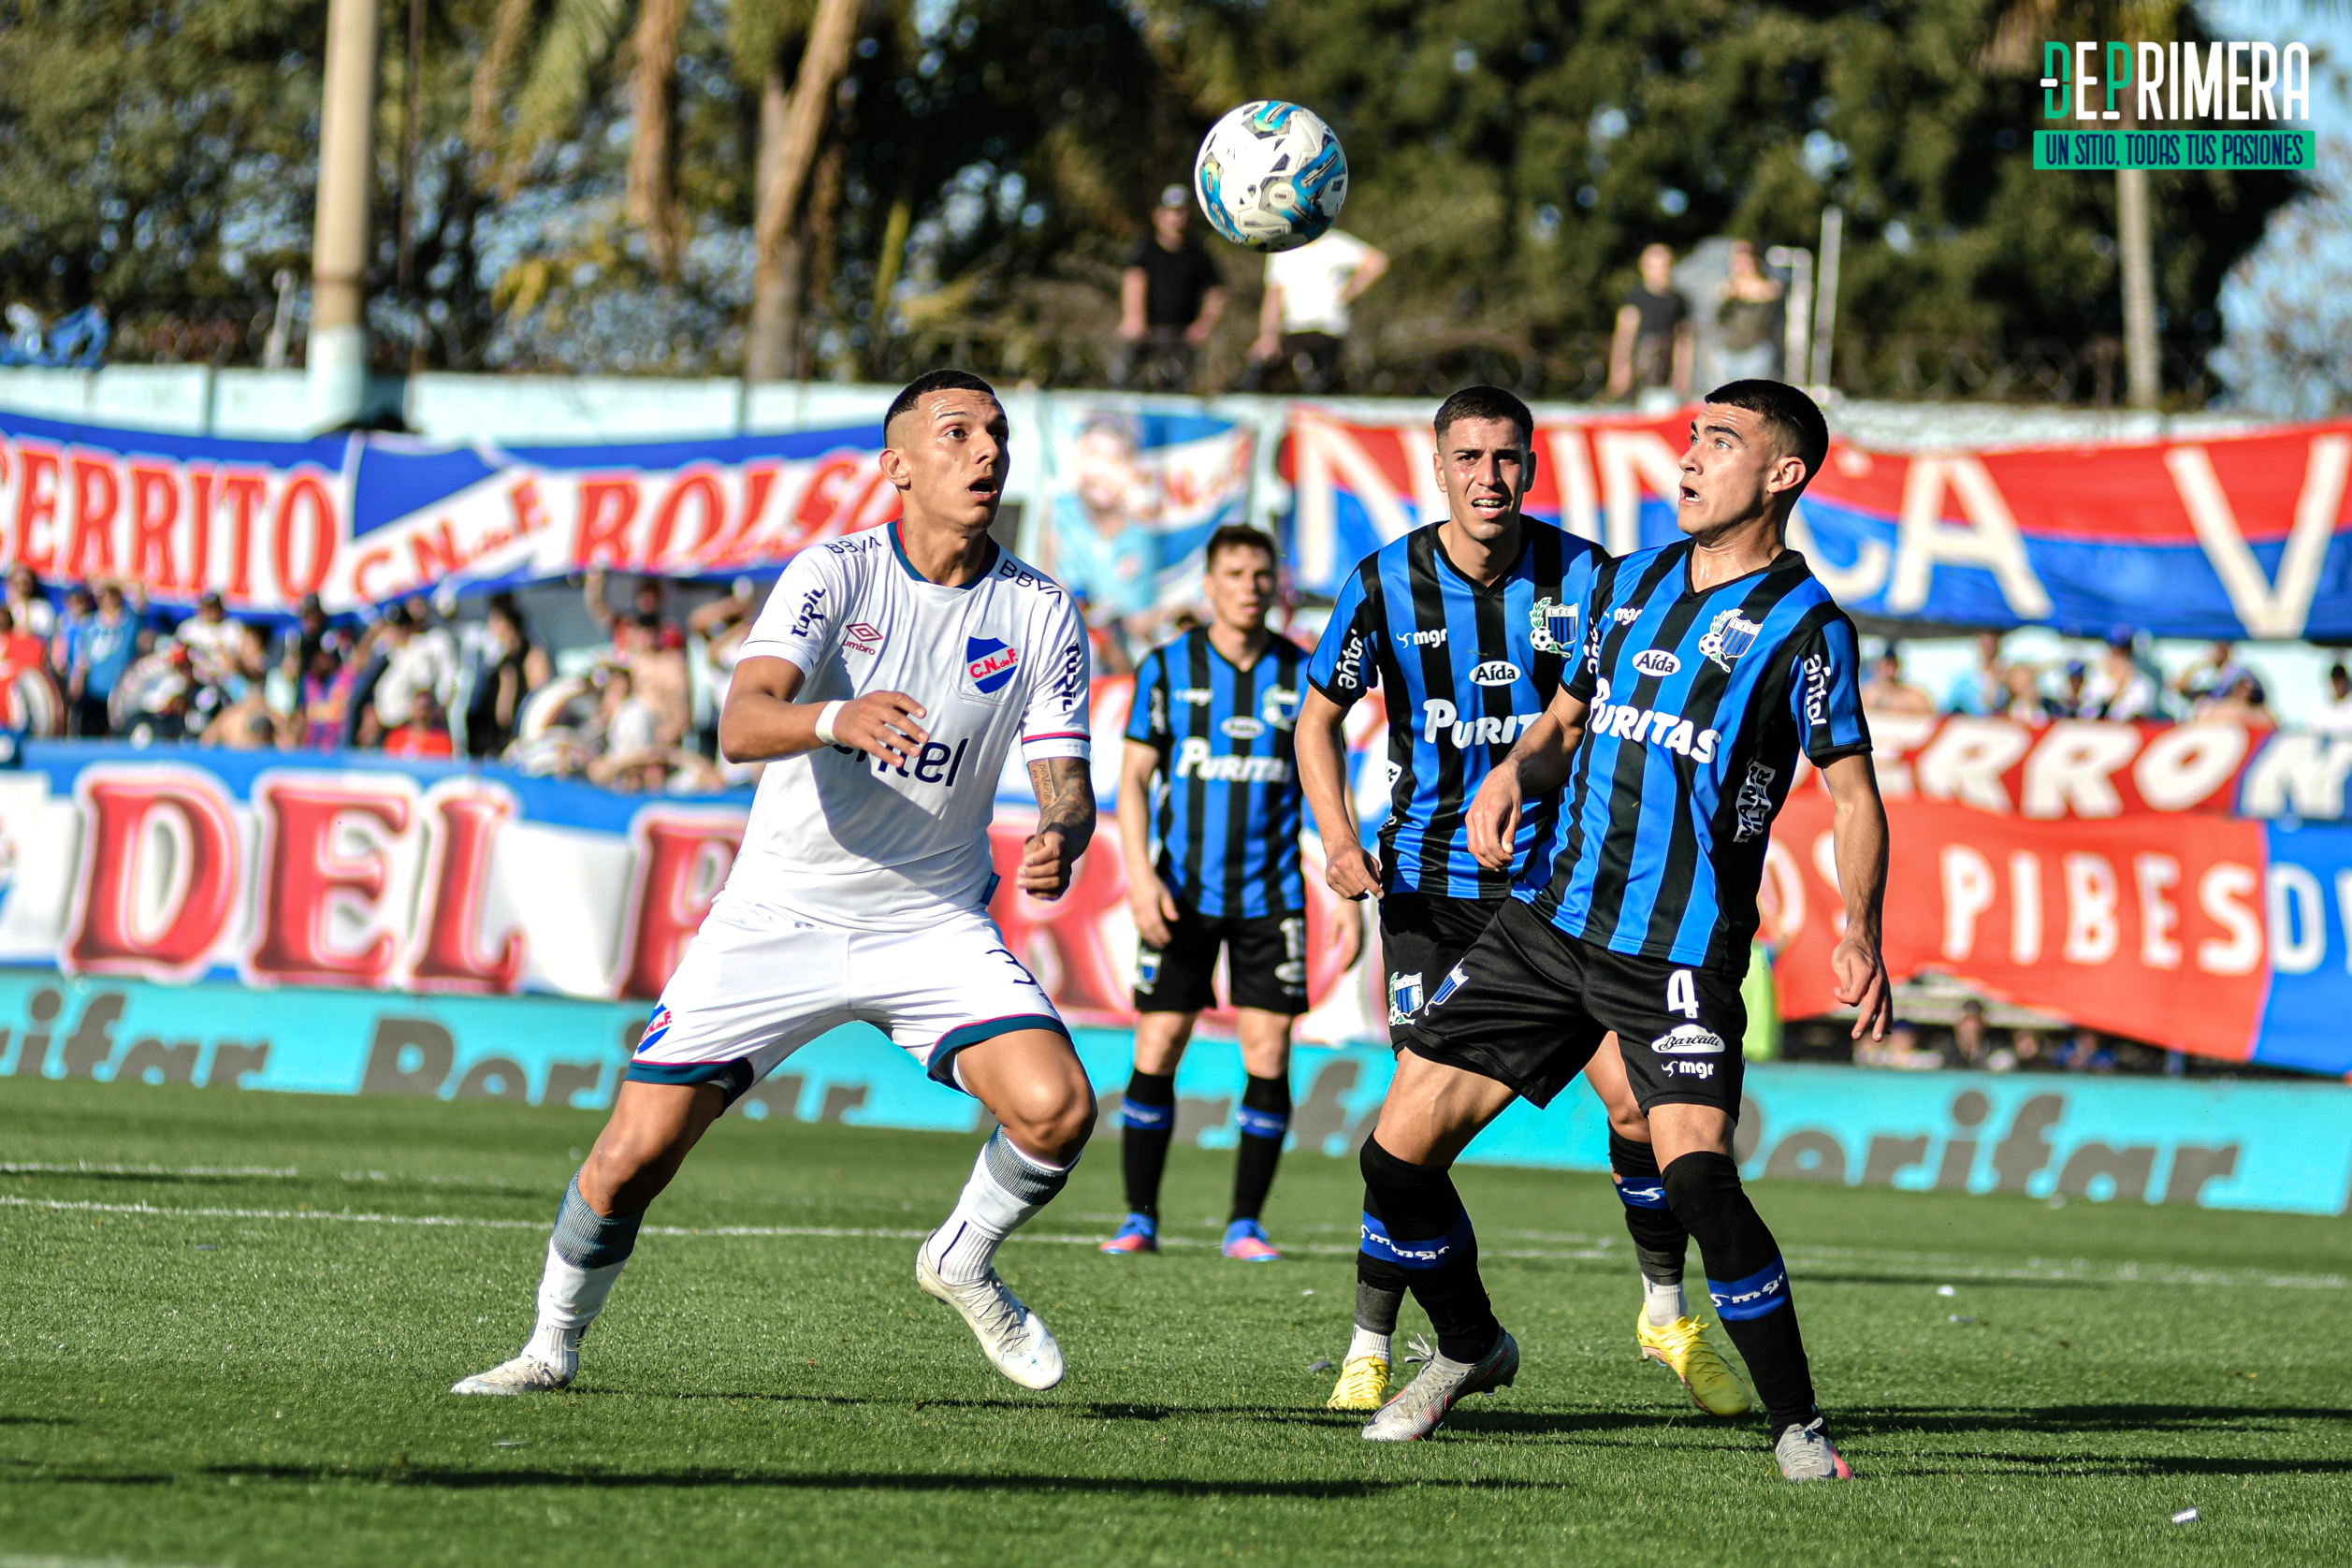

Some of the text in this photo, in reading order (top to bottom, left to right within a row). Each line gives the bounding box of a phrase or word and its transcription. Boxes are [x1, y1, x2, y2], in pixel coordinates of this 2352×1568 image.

[0, 432, 339, 606] ERRITO
[999, 559, 1063, 605] BBVA
[1614, 608, 1643, 625] mgr
[843, 638, 876, 656] umbro
[1413, 628, 1447, 648] mgr
[1474, 664, 1517, 683] Aída
[1635, 652, 1676, 674] Aída
[64, 775, 522, 995] DEL
[1938, 842, 2263, 977] PIBES
[1667, 969, 1699, 1019] 4
[1678, 1060, 1714, 1080] mgr
